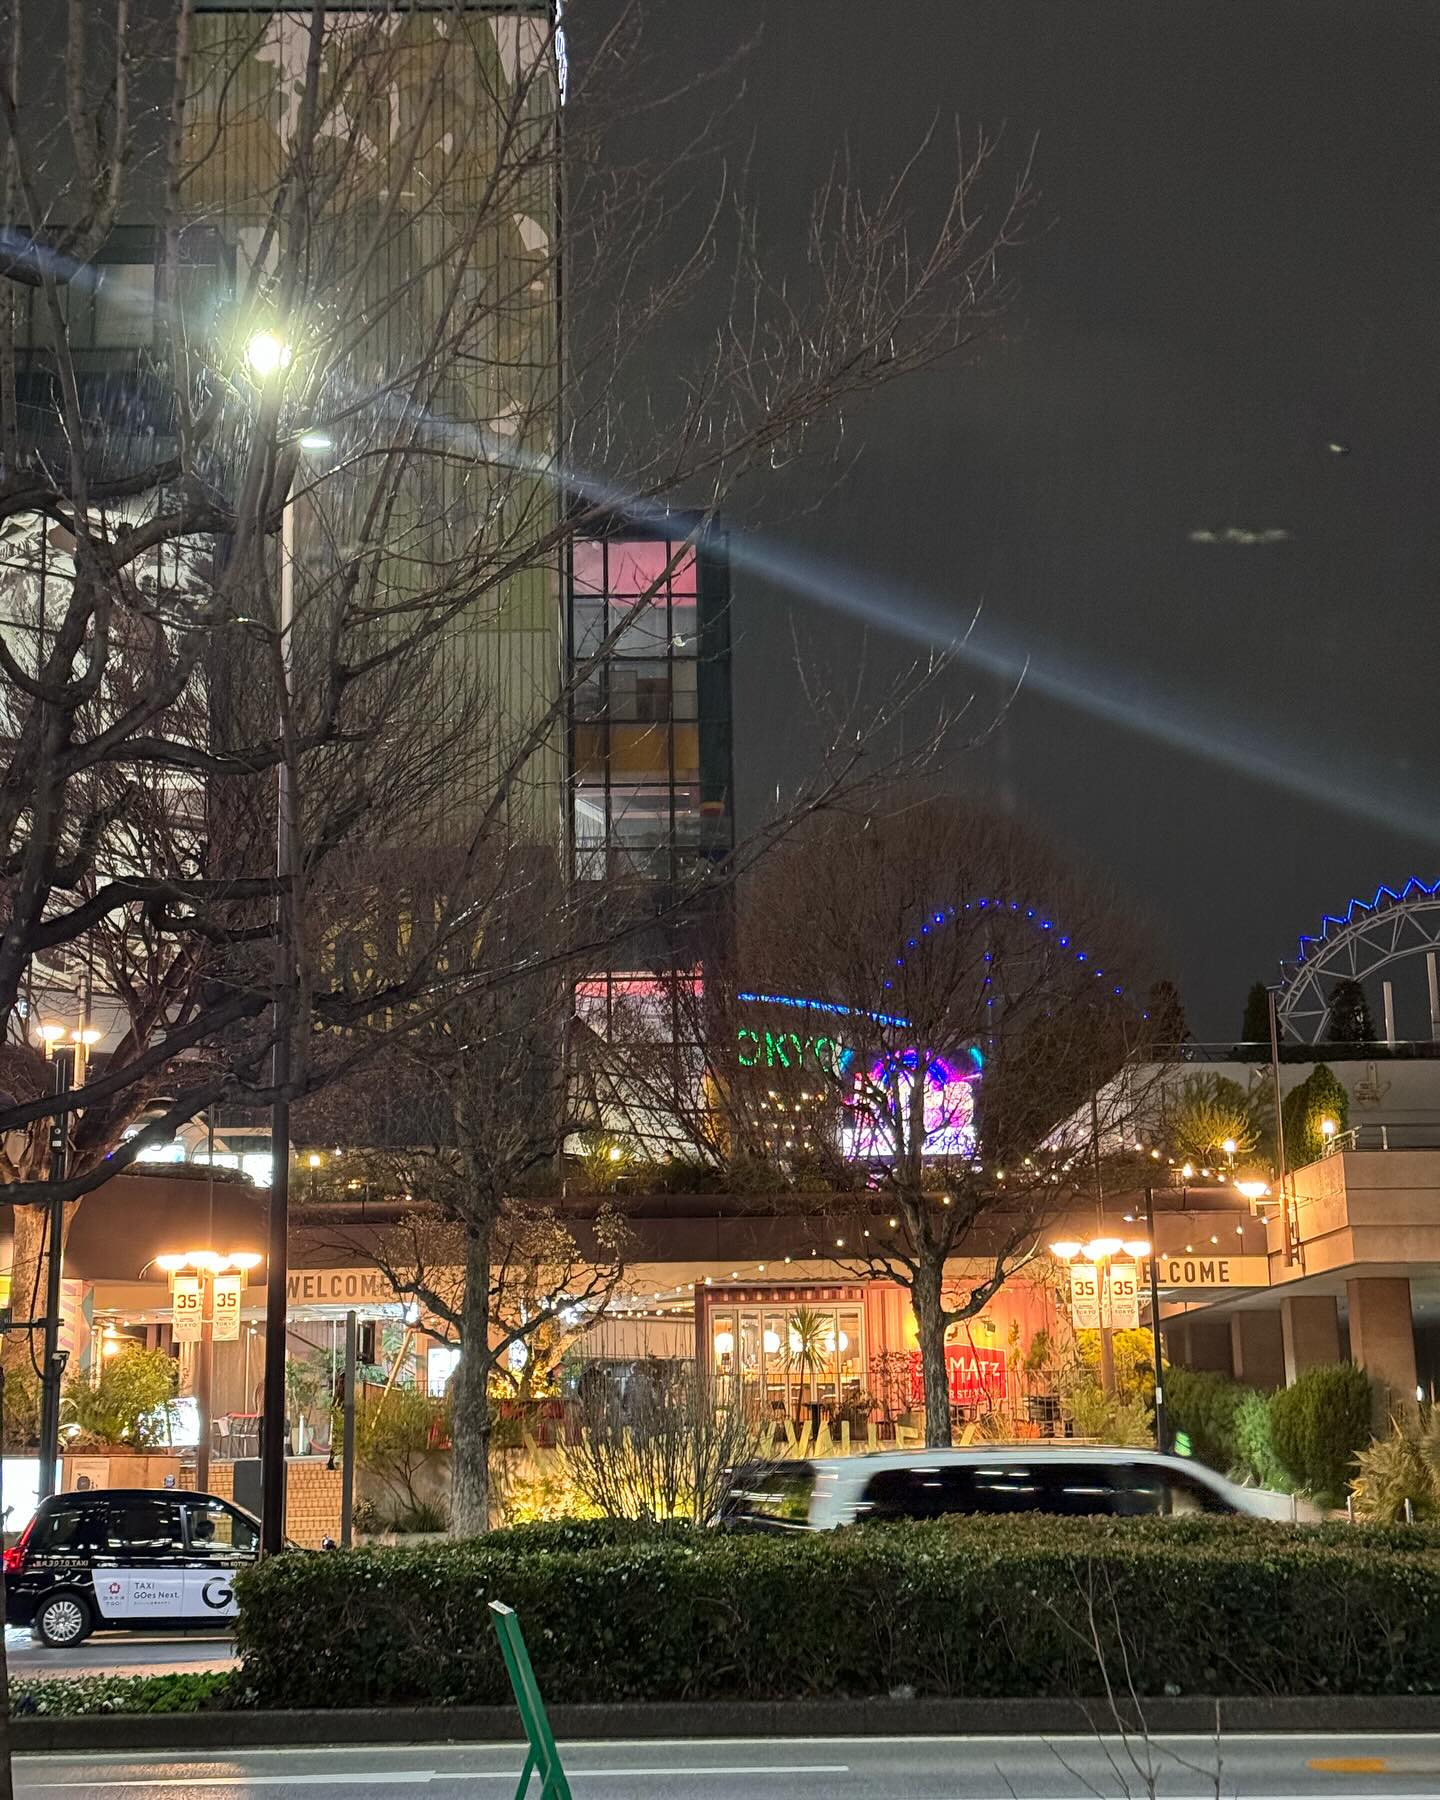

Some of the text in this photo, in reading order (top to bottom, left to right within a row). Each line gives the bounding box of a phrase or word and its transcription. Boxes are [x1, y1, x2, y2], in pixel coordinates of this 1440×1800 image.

[1142, 1261, 1230, 1283] ELCOME
[1074, 1281, 1095, 1296] 35
[1113, 1281, 1134, 1296] 35
[177, 1294, 197, 1309] 35
[217, 1292, 237, 1307] 35
[133, 1591, 156, 1599] GOes
